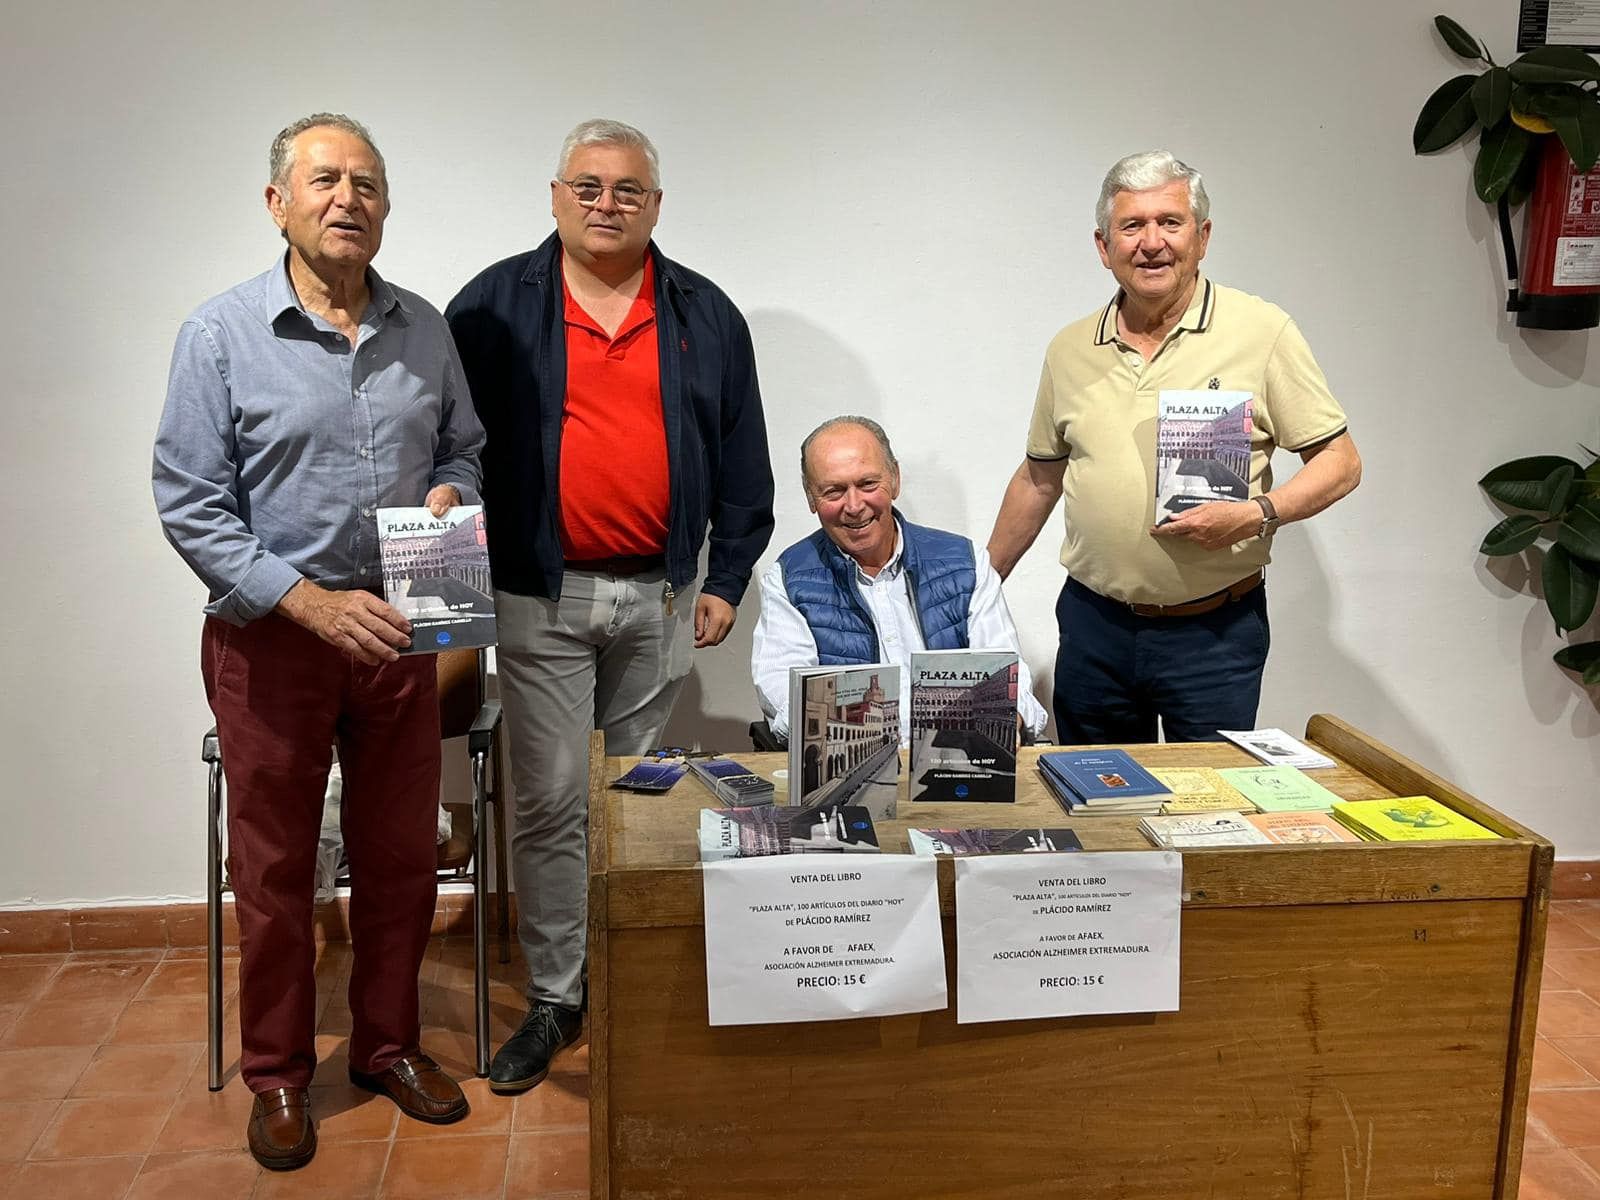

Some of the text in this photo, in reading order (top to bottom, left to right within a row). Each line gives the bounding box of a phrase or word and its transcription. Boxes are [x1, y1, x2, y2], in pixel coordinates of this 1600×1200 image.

[1166, 406, 1229, 414] PLAZA ALTA
[387, 521, 457, 532] PLAZA ALTA
[920, 670, 990, 680] PLAZA ALTA
[791, 872, 861, 884] VENTA DEL LIBRO
[810, 901, 846, 909] ARTÍCULOS
[1040, 905, 1073, 914] PLÁCIDO
[1076, 903, 1112, 913] RAMÍREZ
[796, 915, 831, 925] PLÁCIDO
[834, 913, 871, 923] RAMÍREZ
[792, 946, 820, 955] FAVOR
[822, 945, 833, 953] DE
[992, 949, 1041, 960] ASOCIACIÓN
[1043, 947, 1088, 957] ALZHEIMER
[764, 960, 805, 970] ASOCIACIÓN
[807, 960, 843, 968] ALZHEIMER
[797, 974, 866, 988] PRECIO: 15 €
[1040, 975, 1104, 988] PRECIO: 15 €
